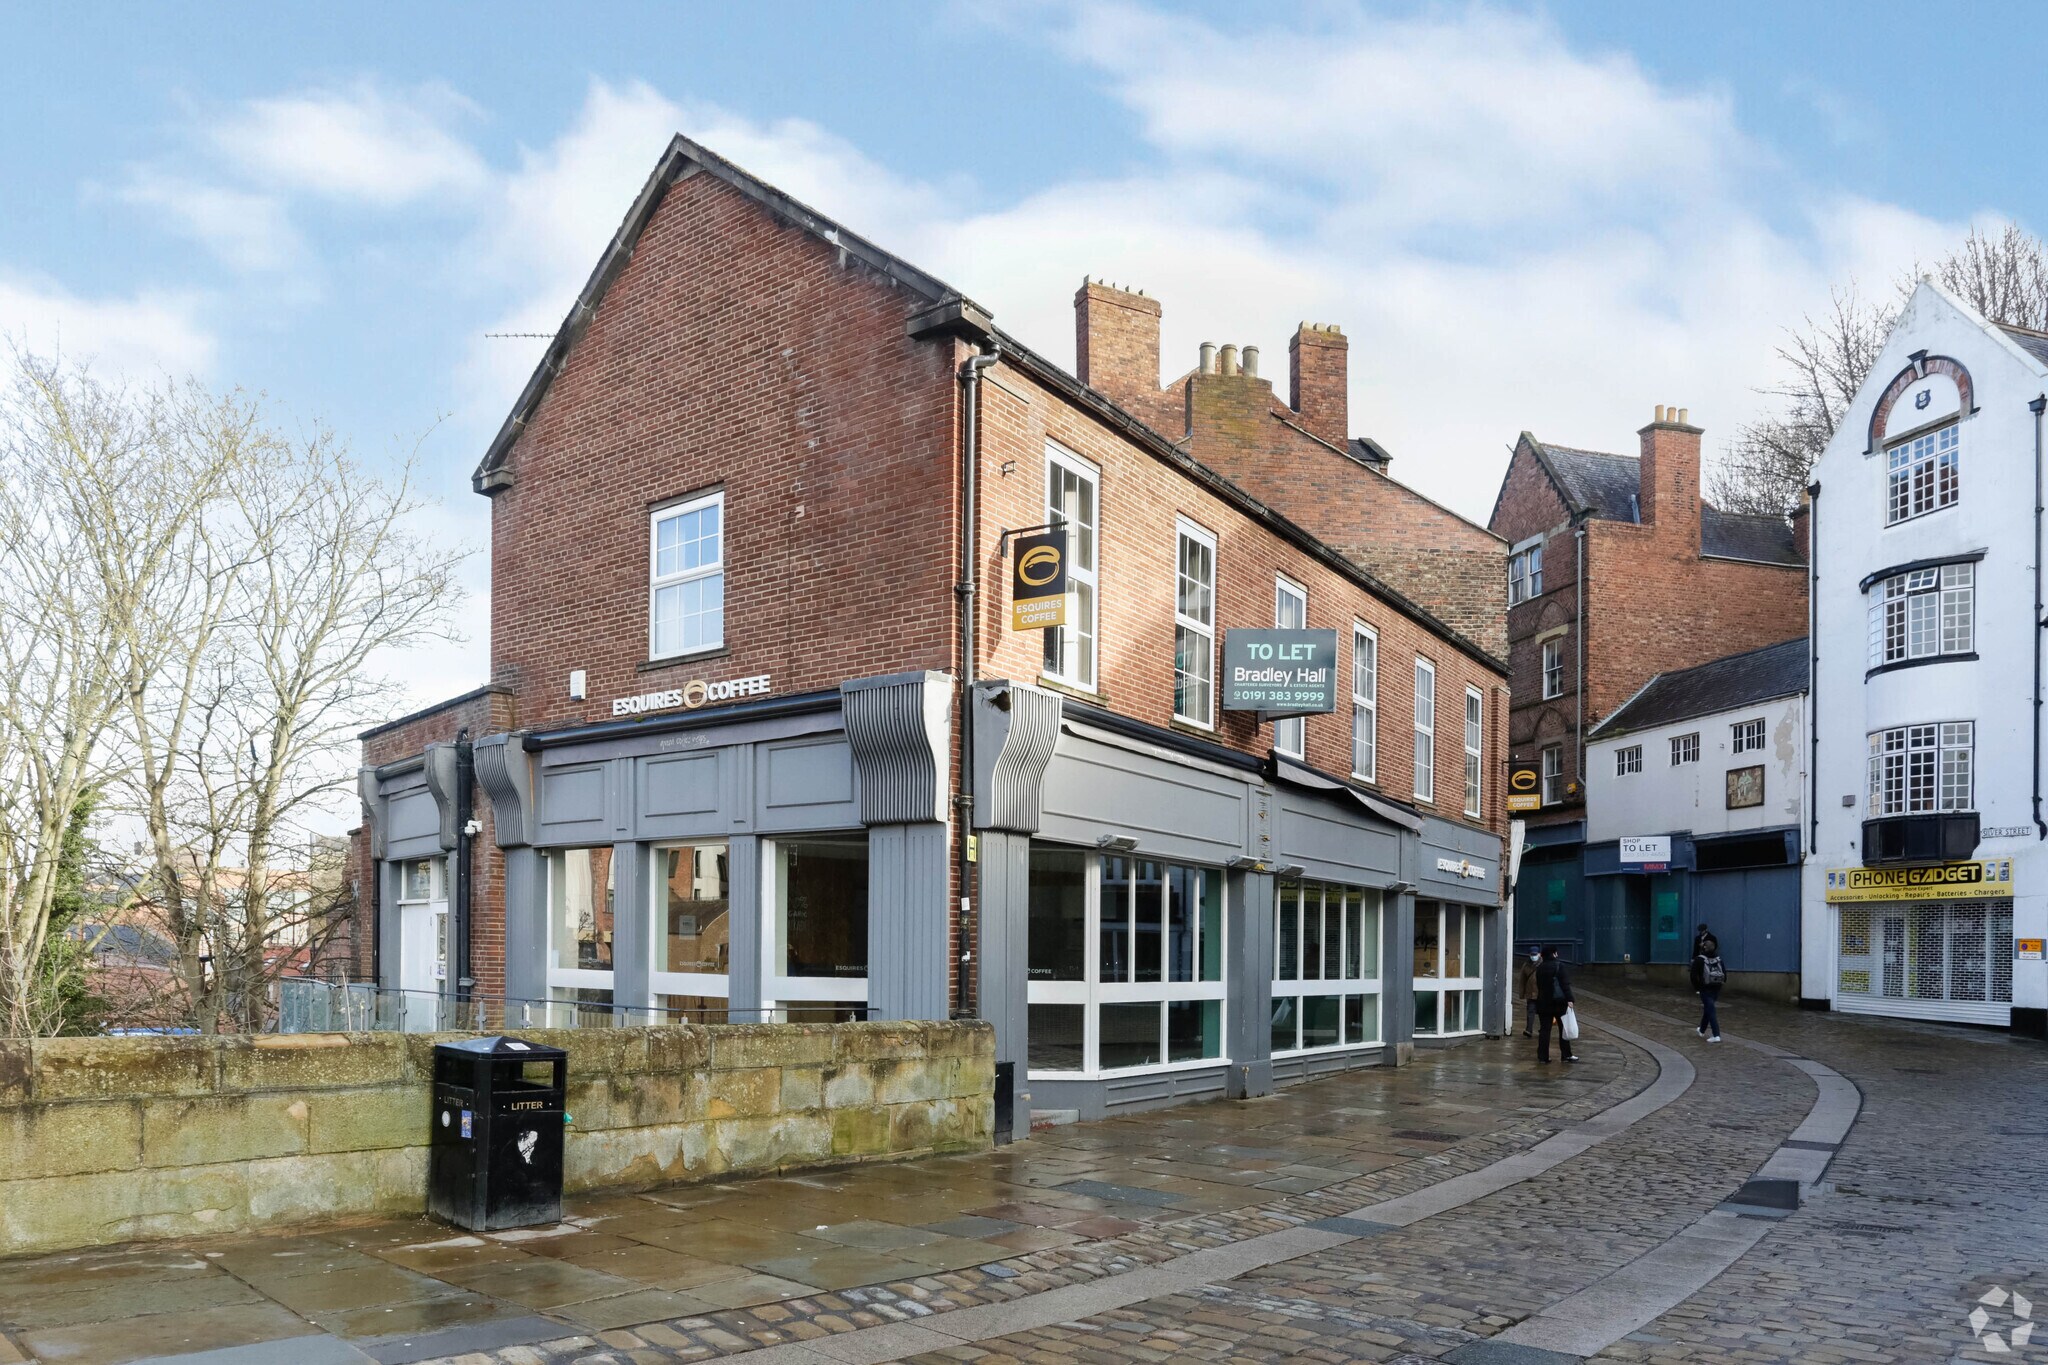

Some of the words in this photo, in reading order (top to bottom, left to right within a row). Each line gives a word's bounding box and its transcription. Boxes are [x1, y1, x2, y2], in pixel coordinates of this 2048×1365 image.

[1016, 600, 1062, 613] ESQUIRES
[1021, 611, 1057, 624] COFFEE
[1247, 643, 1274, 660] TO
[1278, 644, 1317, 660] LET
[1234, 667, 1293, 687] Bradley
[1297, 668, 1326, 683] Hall
[612, 689, 684, 716] ESQUIRES
[707, 674, 771, 701] COFFEE
[1242, 690, 1266, 700] 0191
[1268, 691, 1291, 700] 383
[1294, 691, 1325, 701] 9999
[1982, 829, 2002, 837] SILVER
[2005, 827, 2030, 836] STREET
[1623, 844, 1637, 852] TO
[1639, 844, 1658, 852] LET
[1853, 870, 1905, 886] PHONE
[443, 1096, 464, 1107] LITTER
[511, 1101, 543, 1111] LITTER
